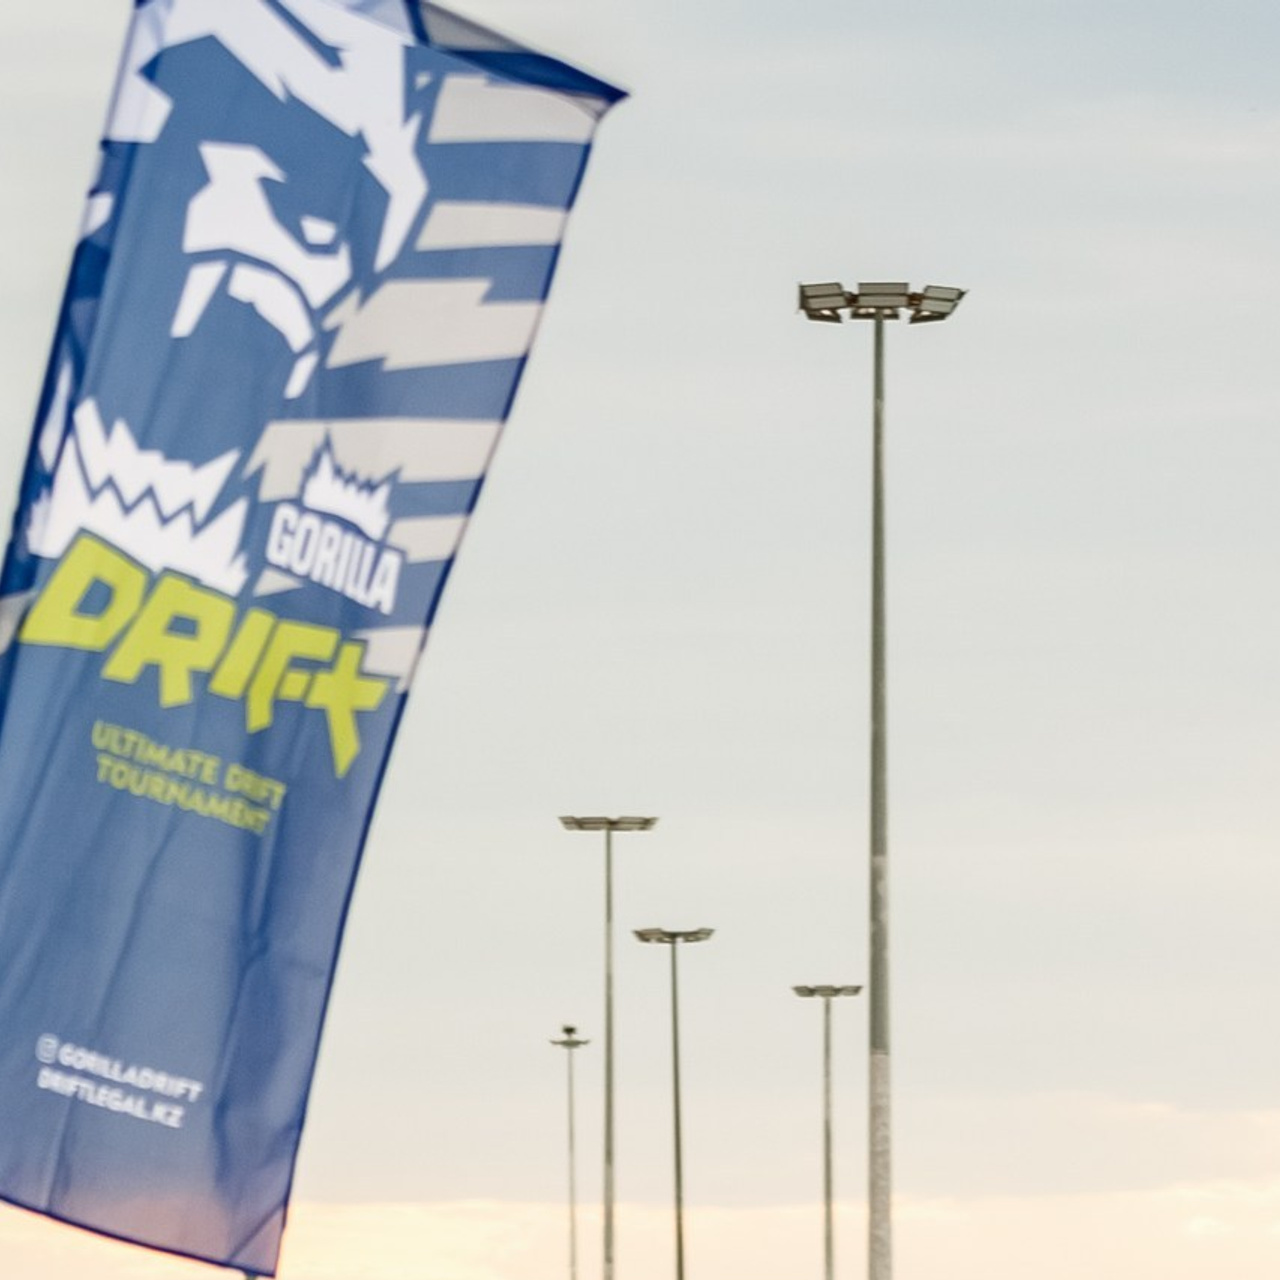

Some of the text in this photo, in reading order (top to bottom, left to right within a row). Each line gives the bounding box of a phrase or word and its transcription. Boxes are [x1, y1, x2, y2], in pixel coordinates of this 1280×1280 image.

[265, 504, 404, 614] GORILLA
[19, 533, 389, 778] DRIFT
[92, 720, 286, 810] ULTIMATE DRIFT
[97, 756, 271, 834] TOURNAMENT
